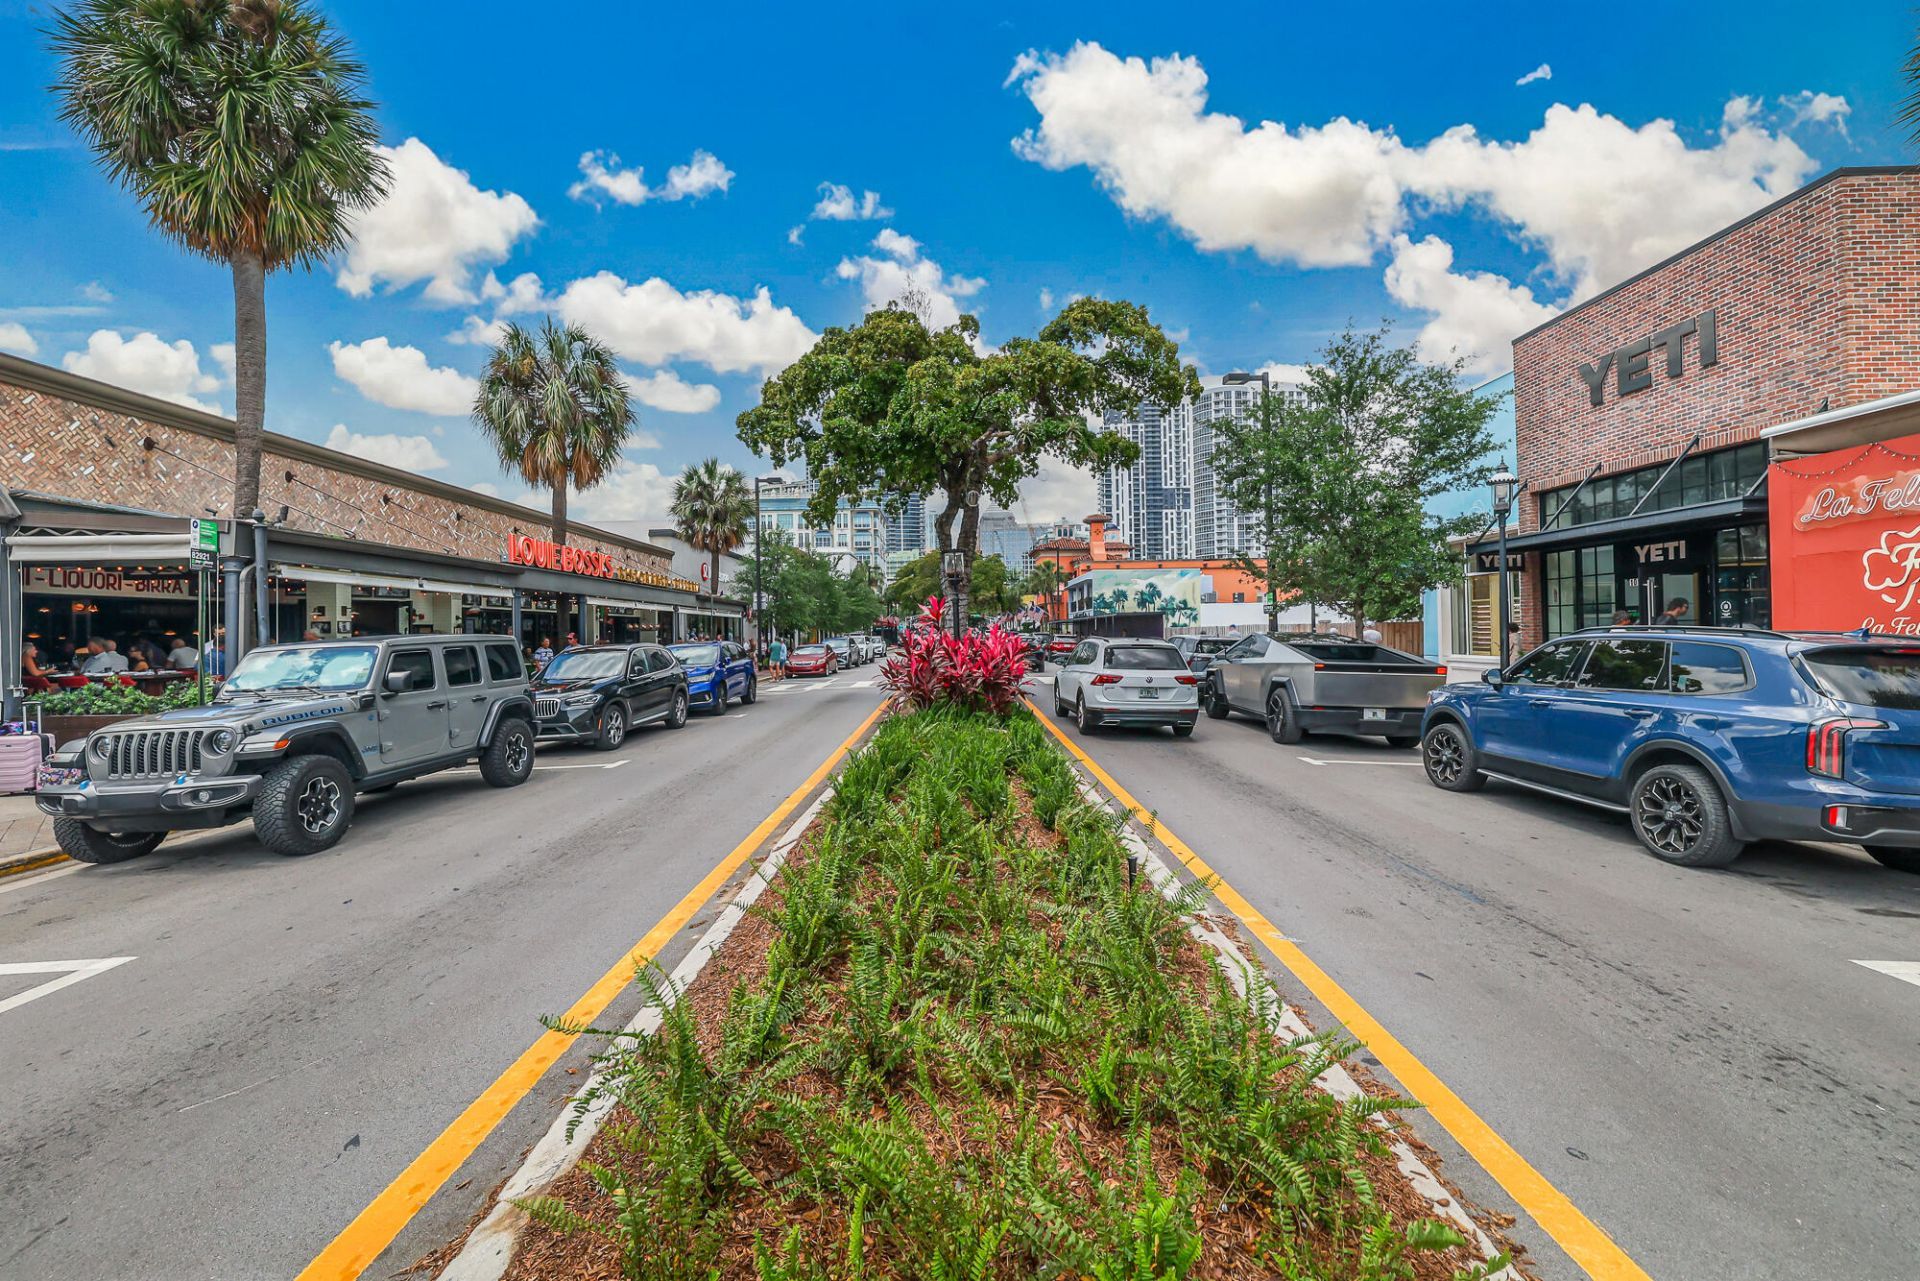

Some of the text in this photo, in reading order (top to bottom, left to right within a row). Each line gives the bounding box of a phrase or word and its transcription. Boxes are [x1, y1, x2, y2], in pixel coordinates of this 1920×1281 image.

[1578, 309, 1718, 406] YETI
[1800, 474, 1920, 522] La Fel
[507, 533, 561, 571] LOUIE
[1480, 554, 1522, 568] YETI
[1634, 540, 1686, 564] YETI
[49, 568, 121, 591] LIQUORI
[135, 579, 183, 594] BIRRA
[262, 706, 344, 726] RUBICON
